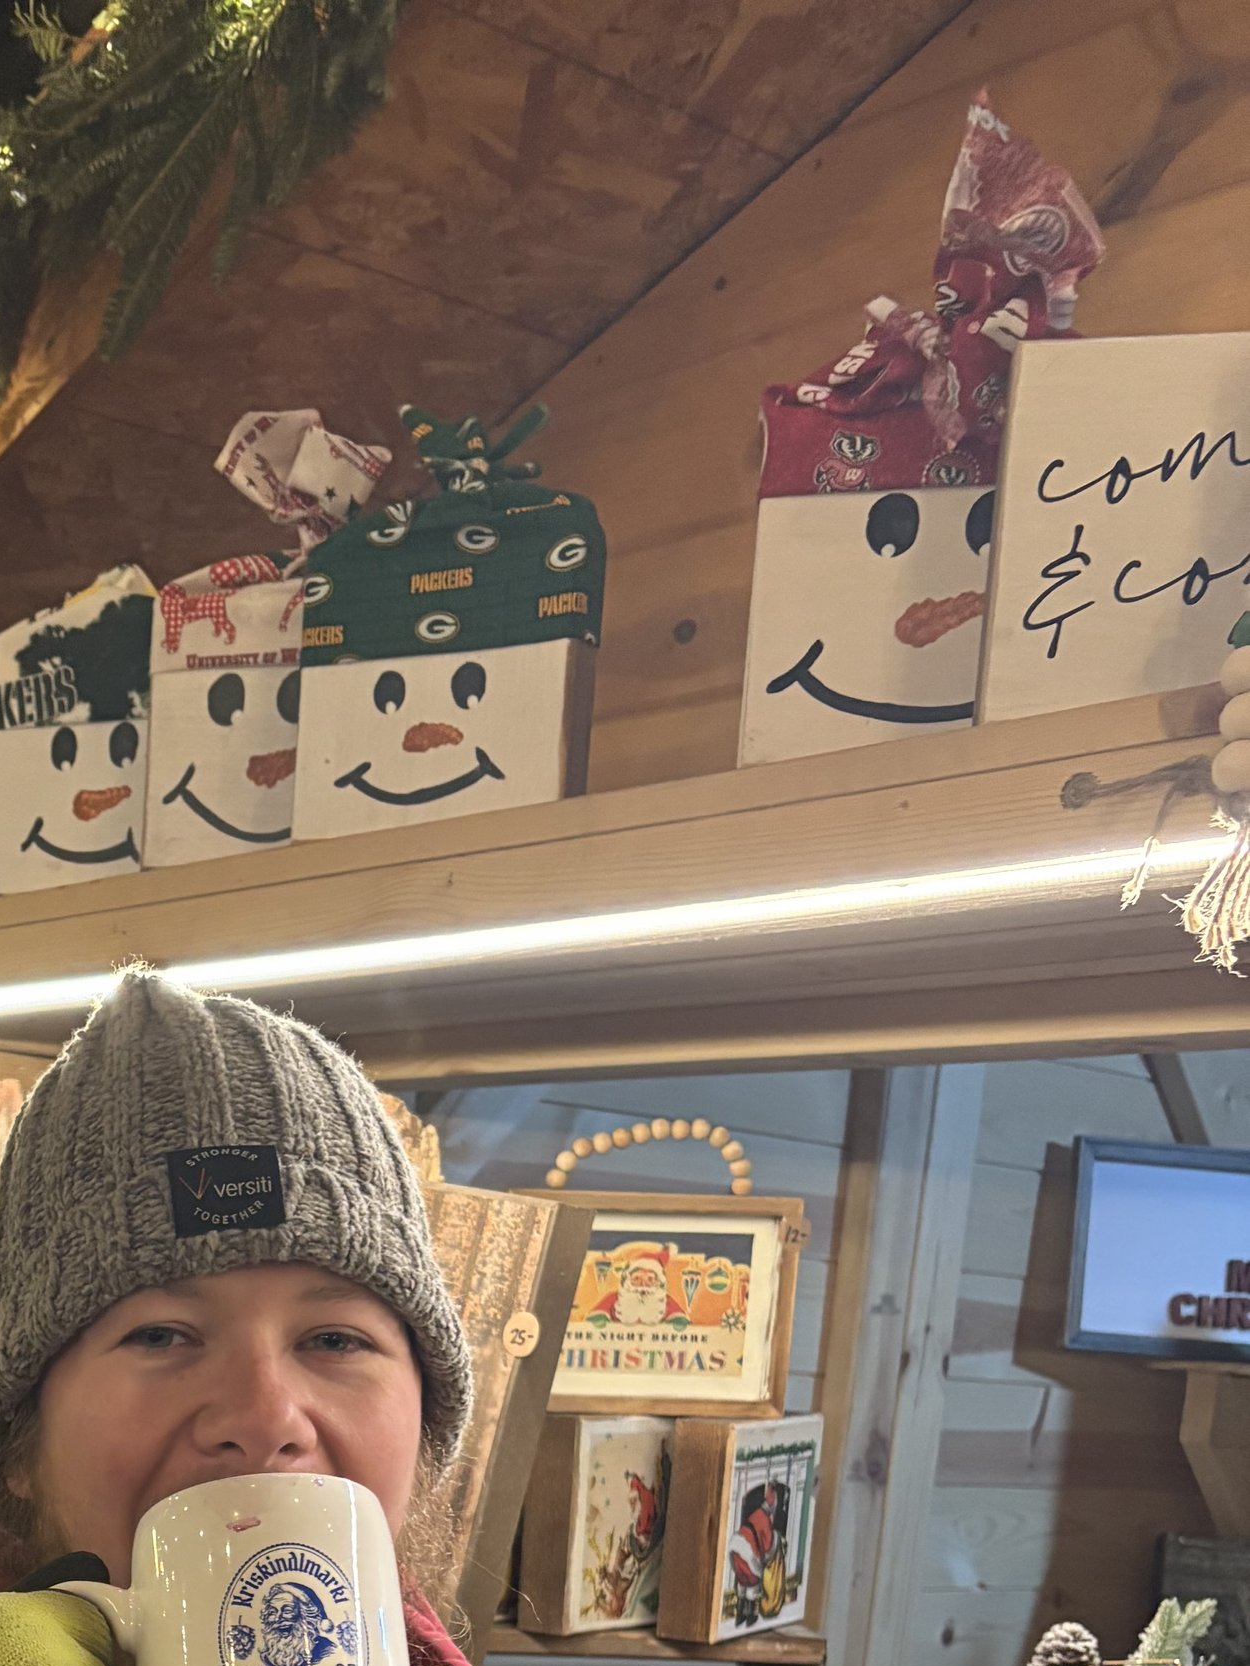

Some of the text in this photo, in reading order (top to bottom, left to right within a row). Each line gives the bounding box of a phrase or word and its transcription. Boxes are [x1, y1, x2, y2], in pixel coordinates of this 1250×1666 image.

[410, 566, 473, 594] PACKERS
[1023, 524, 1250, 658] & co
[185, 1148, 258, 1167] STRONGER
[193, 1200, 265, 1225] TOGETHER
[599, 1332, 645, 1342] NIGHT
[652, 1333, 708, 1343] BEFORE
[561, 1347, 727, 1371] HRISTMAS
[231, 1552, 350, 1608] Kriskindlmarkt
